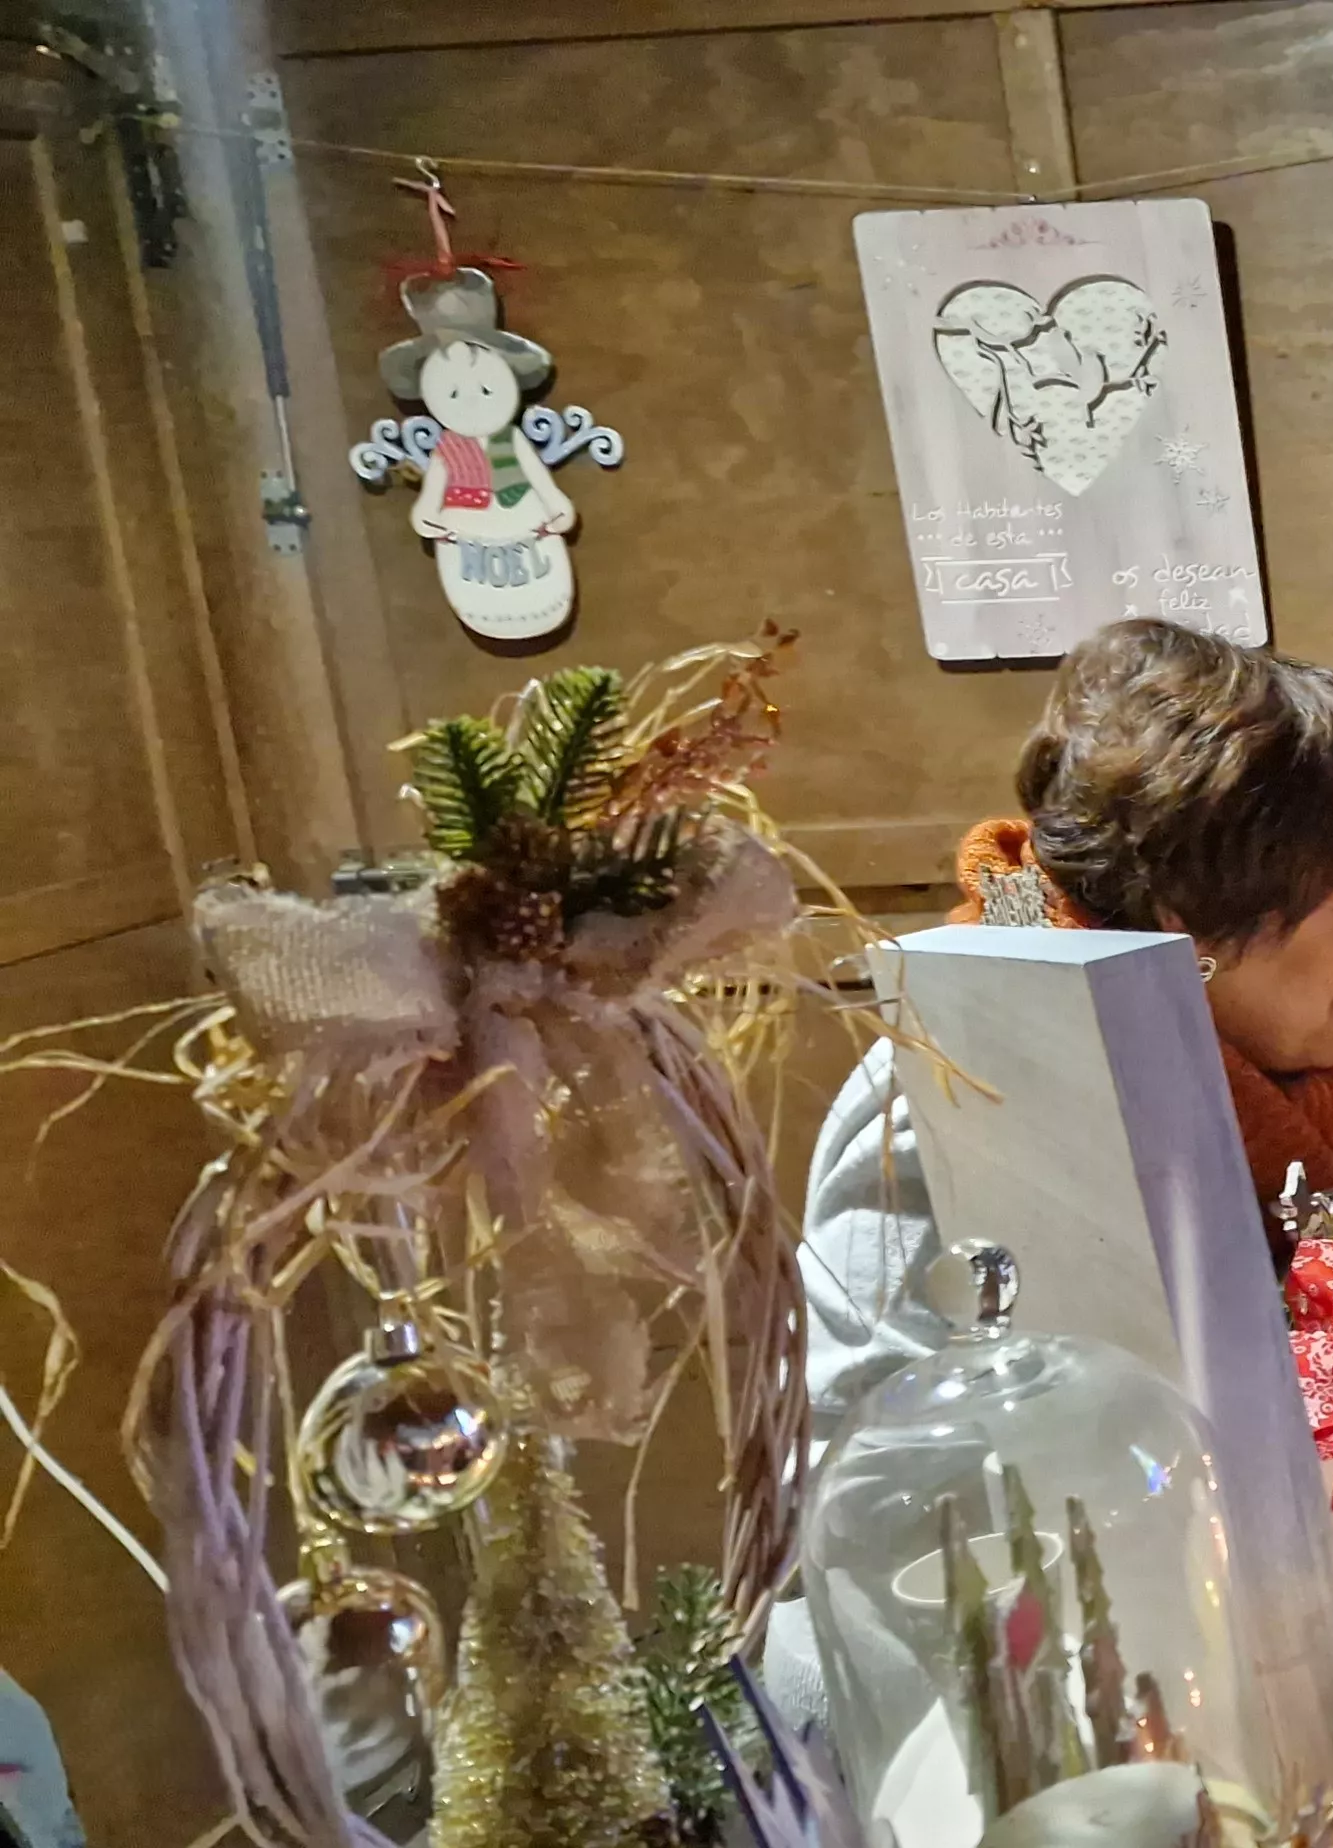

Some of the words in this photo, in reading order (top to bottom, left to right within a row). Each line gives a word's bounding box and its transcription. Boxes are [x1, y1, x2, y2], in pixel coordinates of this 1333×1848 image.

[912, 502, 945, 522] Los
[949, 527, 978, 548] de
[986, 522, 1034, 550] esta
[458, 539, 552, 589] NOEL
[1111, 564, 1141, 589] os
[1151, 552, 1256, 588] desean
[955, 567, 1040, 598] casa
[1157, 588, 1213, 618] feliz
